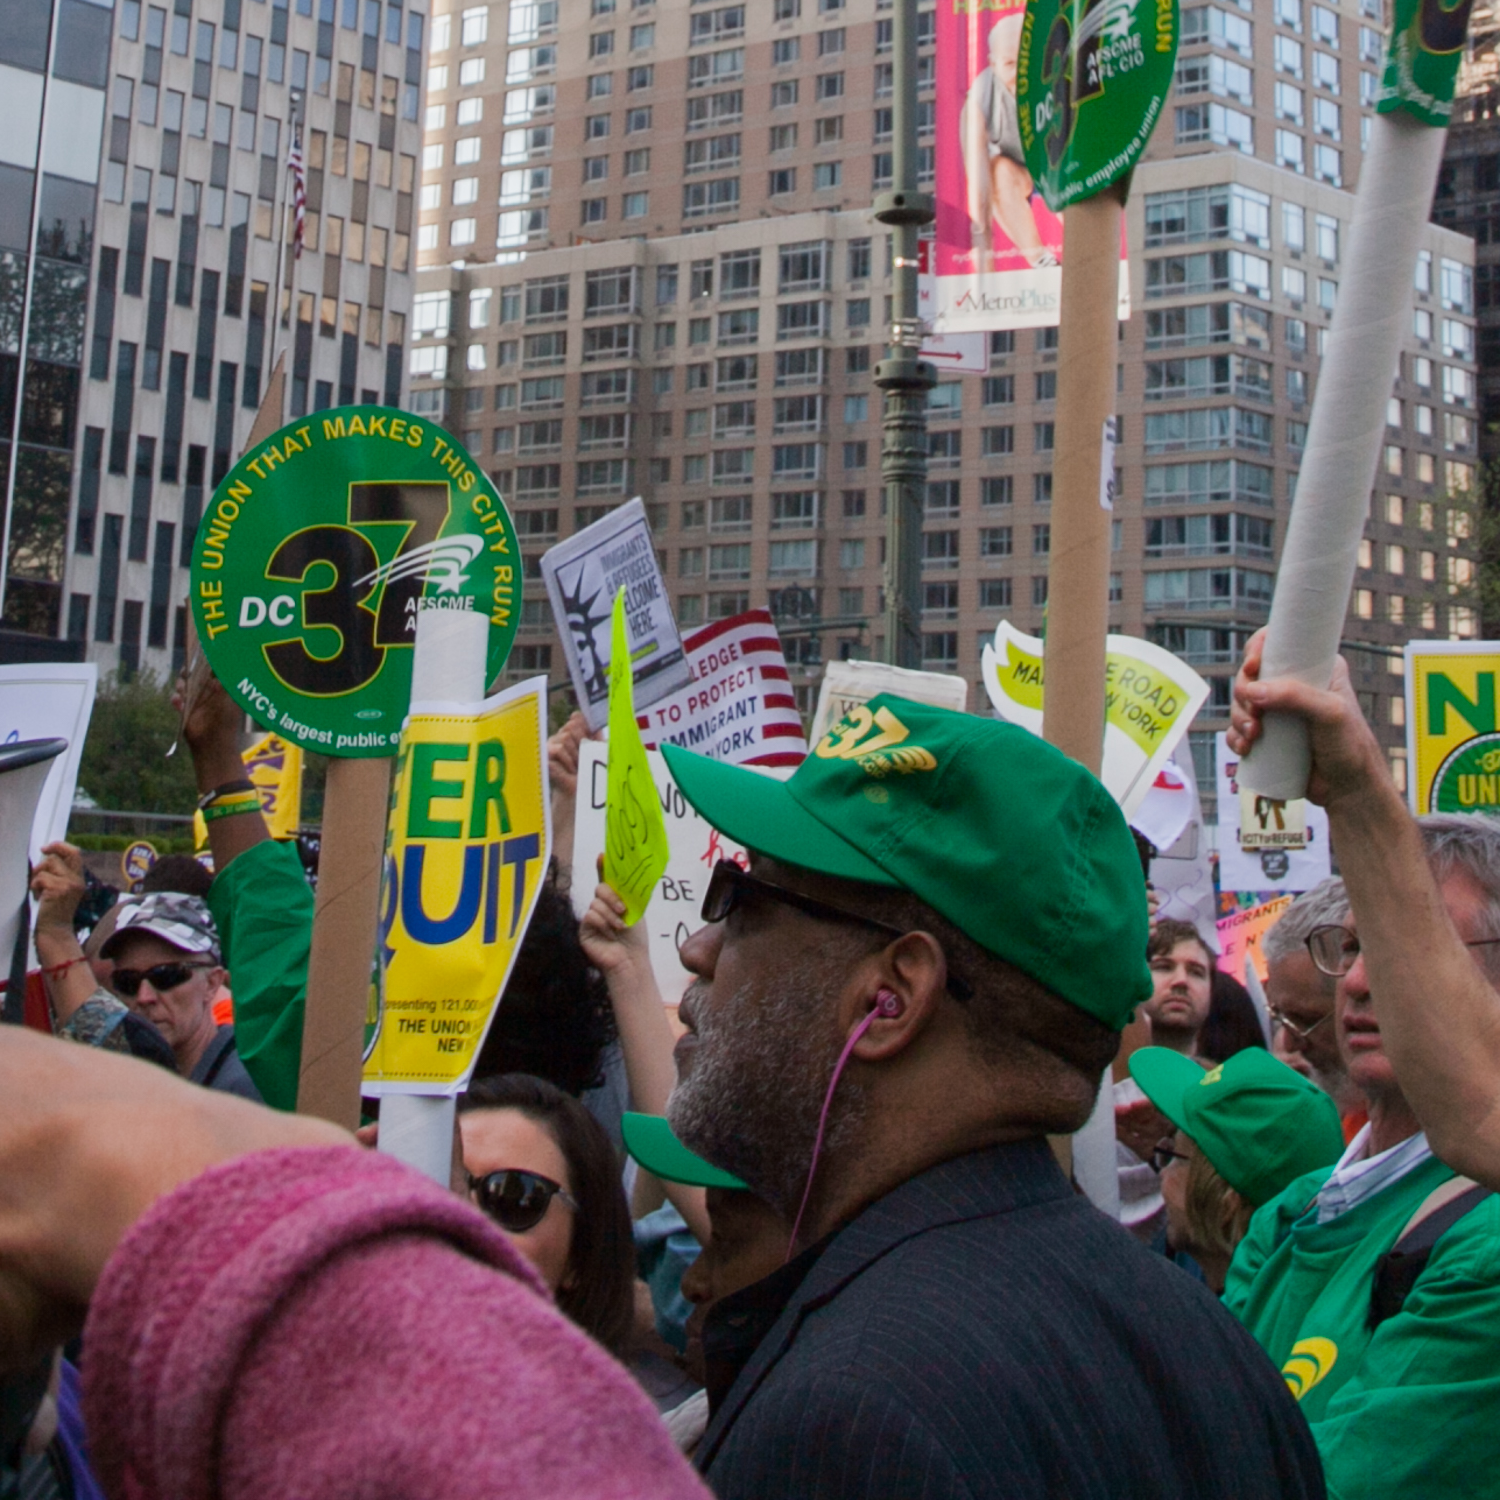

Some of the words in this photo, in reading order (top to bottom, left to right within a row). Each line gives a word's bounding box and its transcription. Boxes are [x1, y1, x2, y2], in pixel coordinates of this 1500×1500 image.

[1018, 11, 1036, 97] UNION
[1085, 133, 1142, 188] employee
[1137, 93, 1163, 141] union
[966, 288, 1058, 313] MetroPlus
[246, 426, 313, 480] THAT
[321, 414, 425, 449] MAKES
[429, 436, 476, 492] THIS
[201, 478, 254, 570] UNION
[470, 493, 510, 556] CITY
[200, 579, 230, 640] THE
[238, 594, 296, 628] DC
[490, 564, 514, 628] RUN
[616, 575, 661, 616] ELCOME
[689, 642, 739, 682] LEDGE
[236, 676, 277, 721] NYC's
[278, 712, 333, 747] largest
[336, 731, 387, 750] public
[656, 704, 682, 727] TO
[687, 665, 755, 716] PROTECT
[1118, 666, 1178, 719] ROAD
[1119, 695, 1163, 741] YORK
[662, 695, 758, 749] MMIGRANT
[815, 705, 910, 760] 37
[404, 736, 513, 840] ER
[661, 879, 696, 902] BE
[398, 1018, 427, 1034] THE
